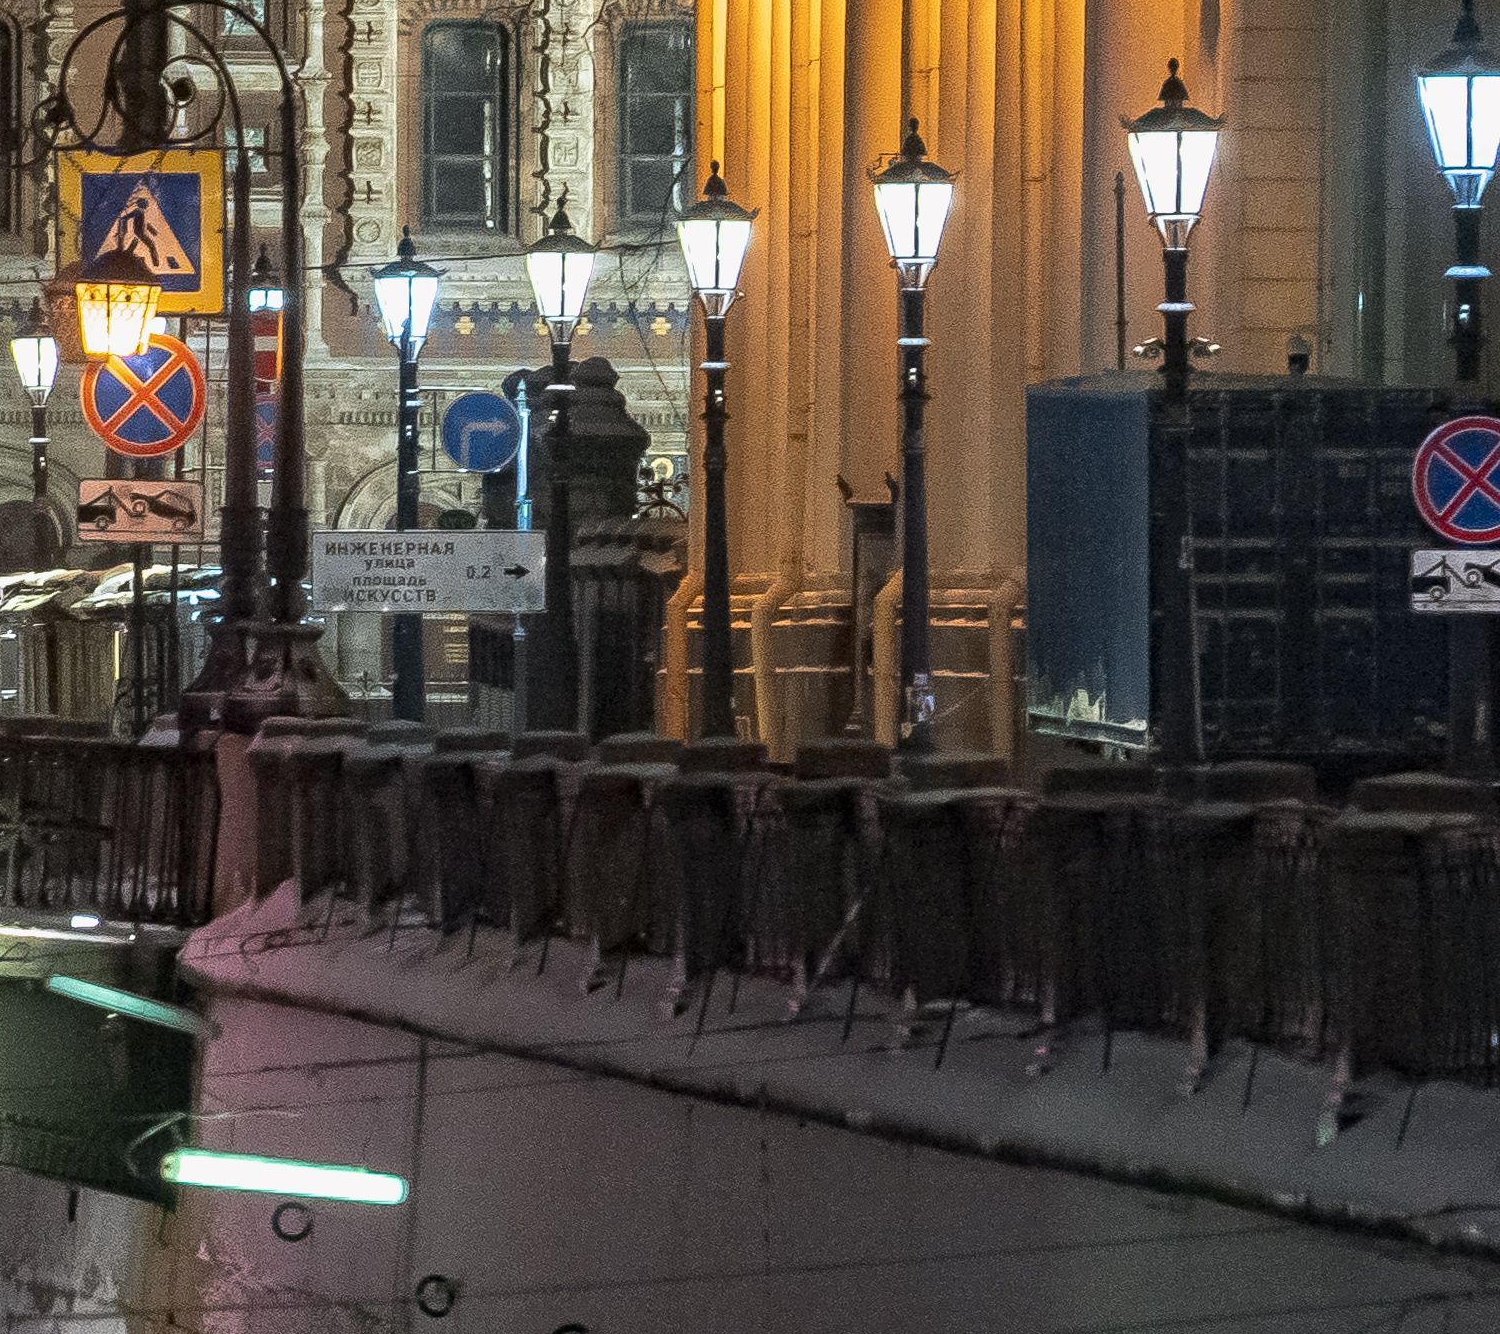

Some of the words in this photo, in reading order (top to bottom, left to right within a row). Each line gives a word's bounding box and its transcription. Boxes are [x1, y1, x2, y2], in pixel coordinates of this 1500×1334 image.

[325, 541, 455, 556] ИНЖЕНЕРНАЯ
[363, 557, 416, 570] улица
[352, 575, 427, 587] площадь
[344, 589, 436, 602] ИСКУССТВ
